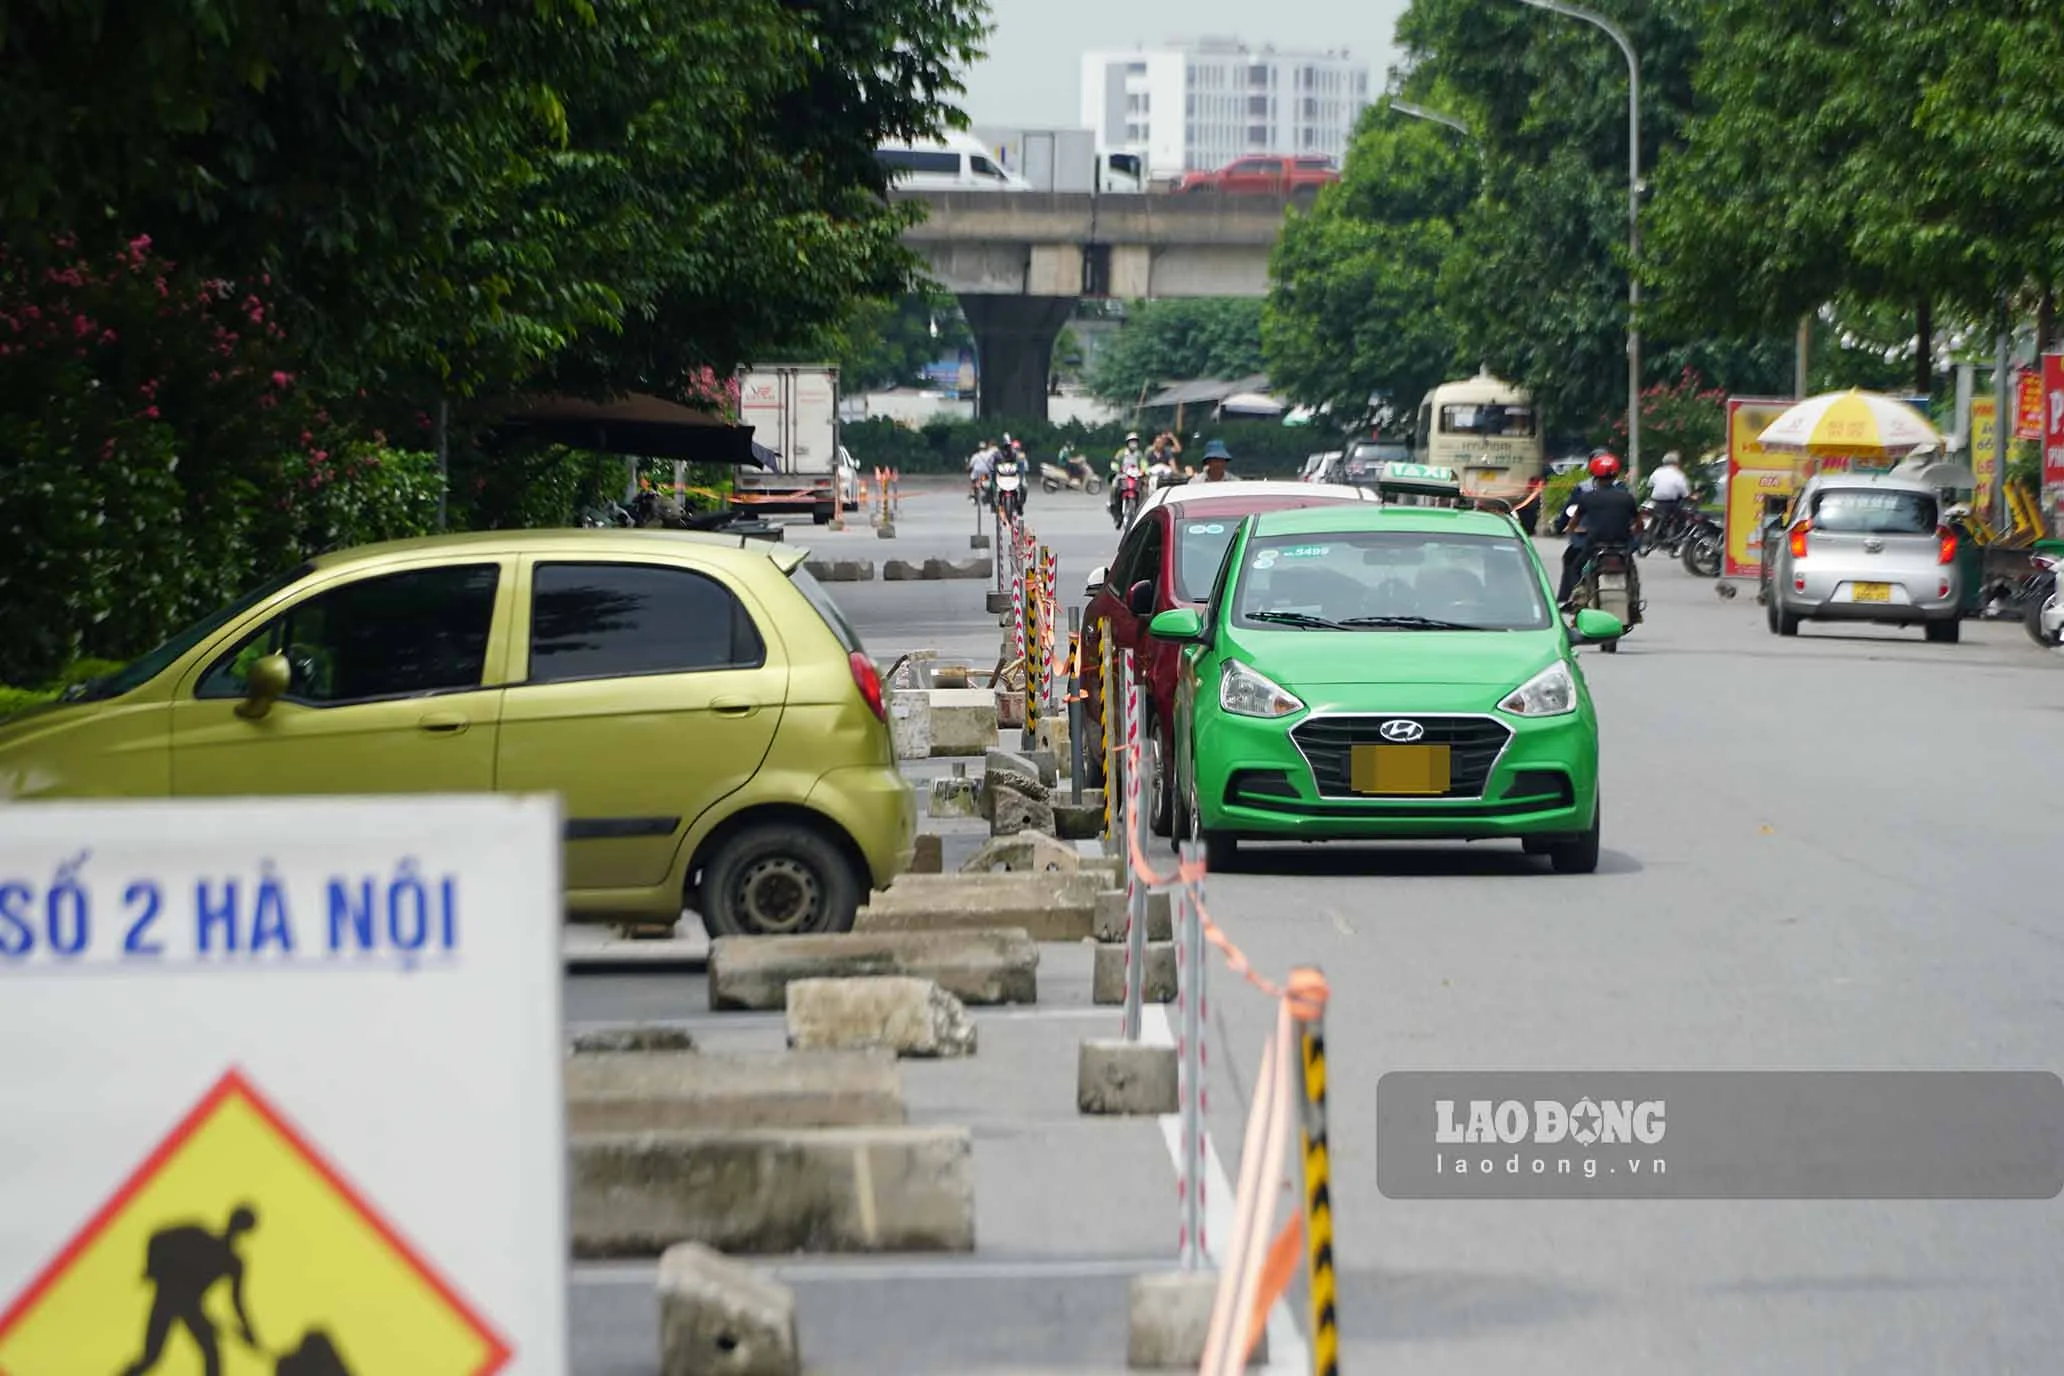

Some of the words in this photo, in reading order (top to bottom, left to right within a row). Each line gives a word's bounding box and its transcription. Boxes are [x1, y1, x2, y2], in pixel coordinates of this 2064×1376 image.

[1392, 462, 1450, 479] TAXI
[0, 849, 91, 957] SỐ
[121, 878, 163, 955] 2
[196, 858, 293, 953] HÀ
[327, 855, 455, 971] NỘI
